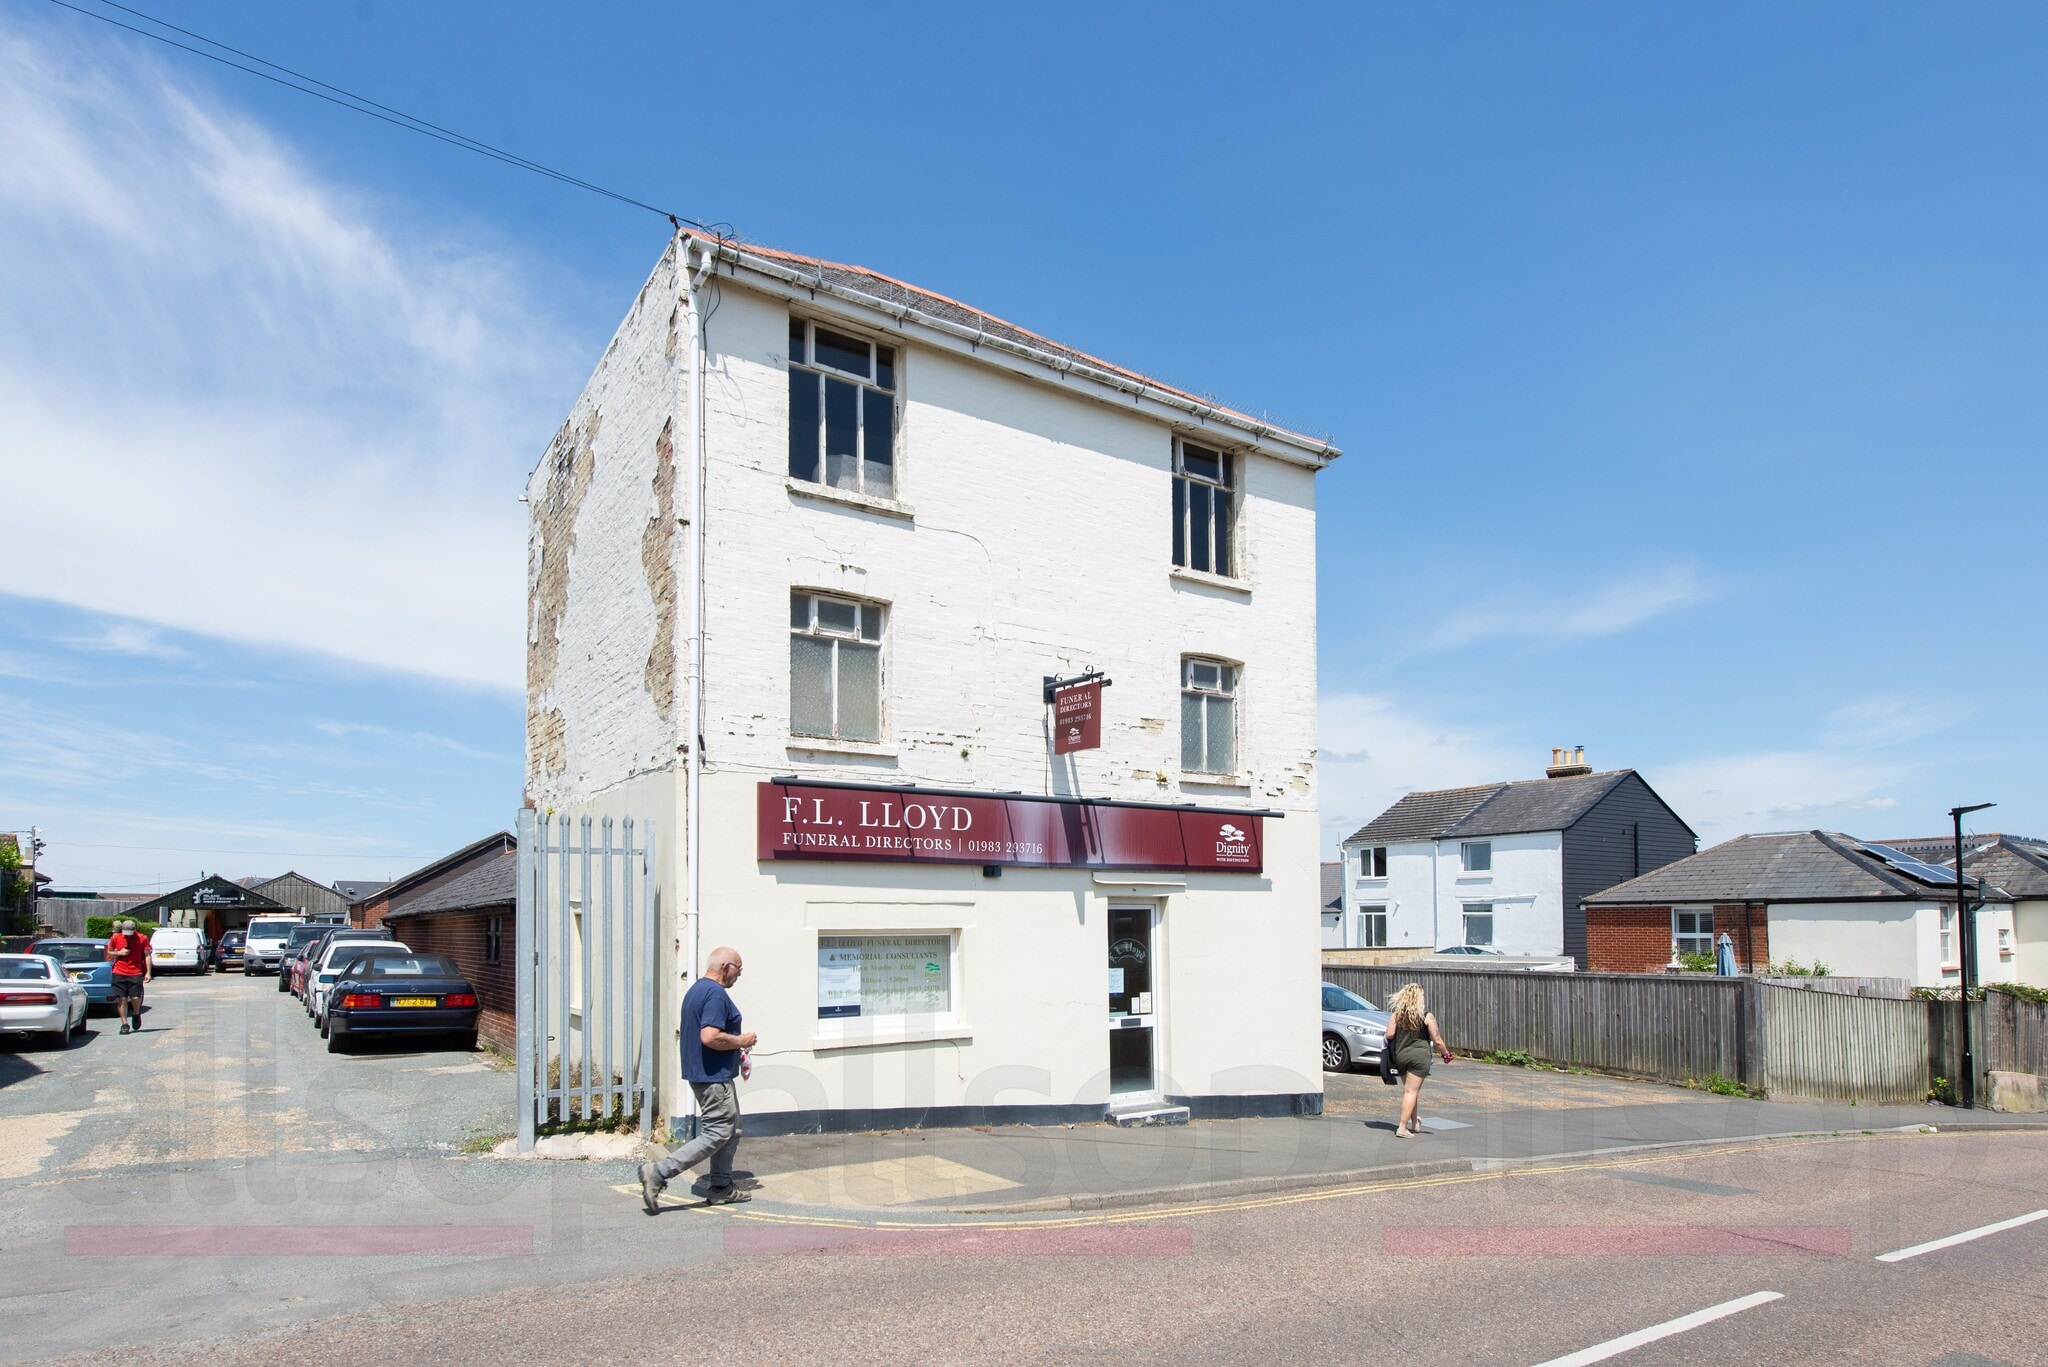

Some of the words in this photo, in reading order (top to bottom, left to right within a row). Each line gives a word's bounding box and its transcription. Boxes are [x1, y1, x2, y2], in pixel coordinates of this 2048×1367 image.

[1061, 692, 1092, 706] FUNERAL
[1060, 701, 1091, 714] DIRECTORS
[782, 796, 843, 826] F.L.
[859, 801, 973, 831] LLOYD
[782, 832, 861, 847] FUNERAL
[865, 835, 952, 850] DIRECTORS
[968, 840, 1001, 852] 01983
[1006, 842, 1043, 854] 293716
[1216, 841, 1250, 858] Dignity
[838, 939, 863, 948] LLOYD
[867, 938, 902, 947] FUNERAL
[905, 937, 946, 946] DIRECTORS
[839, 952, 883, 961] MEMORIAL
[886, 951, 938, 960] CONSULTANTS
